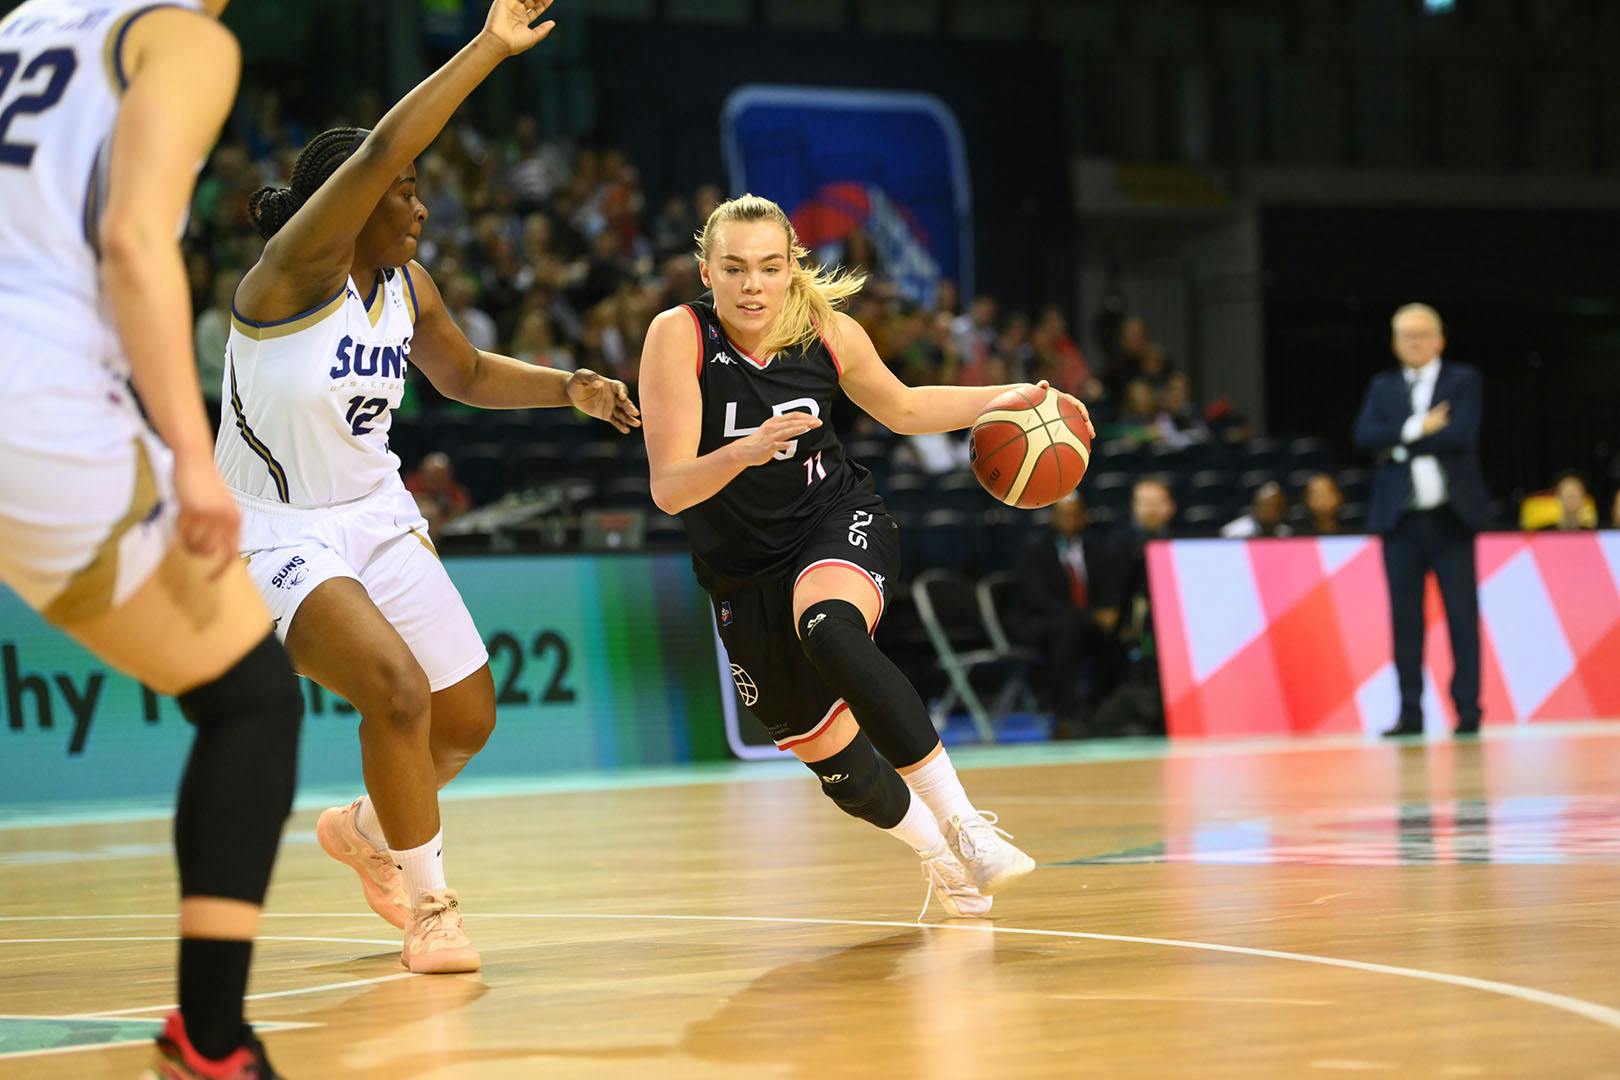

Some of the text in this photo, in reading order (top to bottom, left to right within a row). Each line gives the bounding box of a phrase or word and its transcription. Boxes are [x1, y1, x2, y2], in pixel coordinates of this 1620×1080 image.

[345, 395, 389, 436] 12
[803, 450, 827, 487] 11
[271, 555, 306, 589] SUNS
